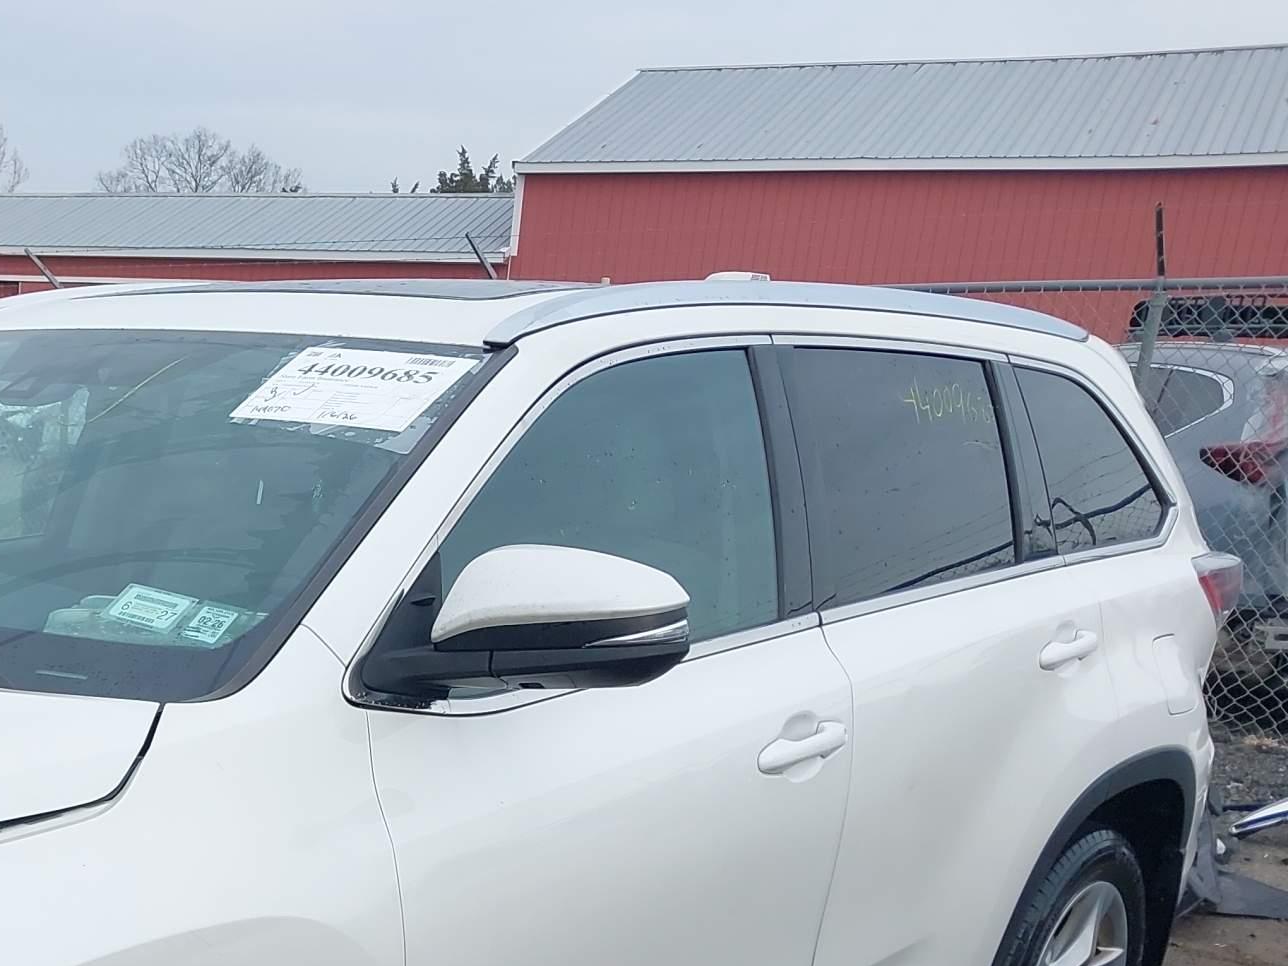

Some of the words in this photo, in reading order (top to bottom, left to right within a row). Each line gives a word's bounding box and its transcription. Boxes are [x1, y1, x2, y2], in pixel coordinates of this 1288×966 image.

[297, 362, 440, 384] 44009685
[120, 601, 133, 611] 6
[156, 610, 178, 622] 27
